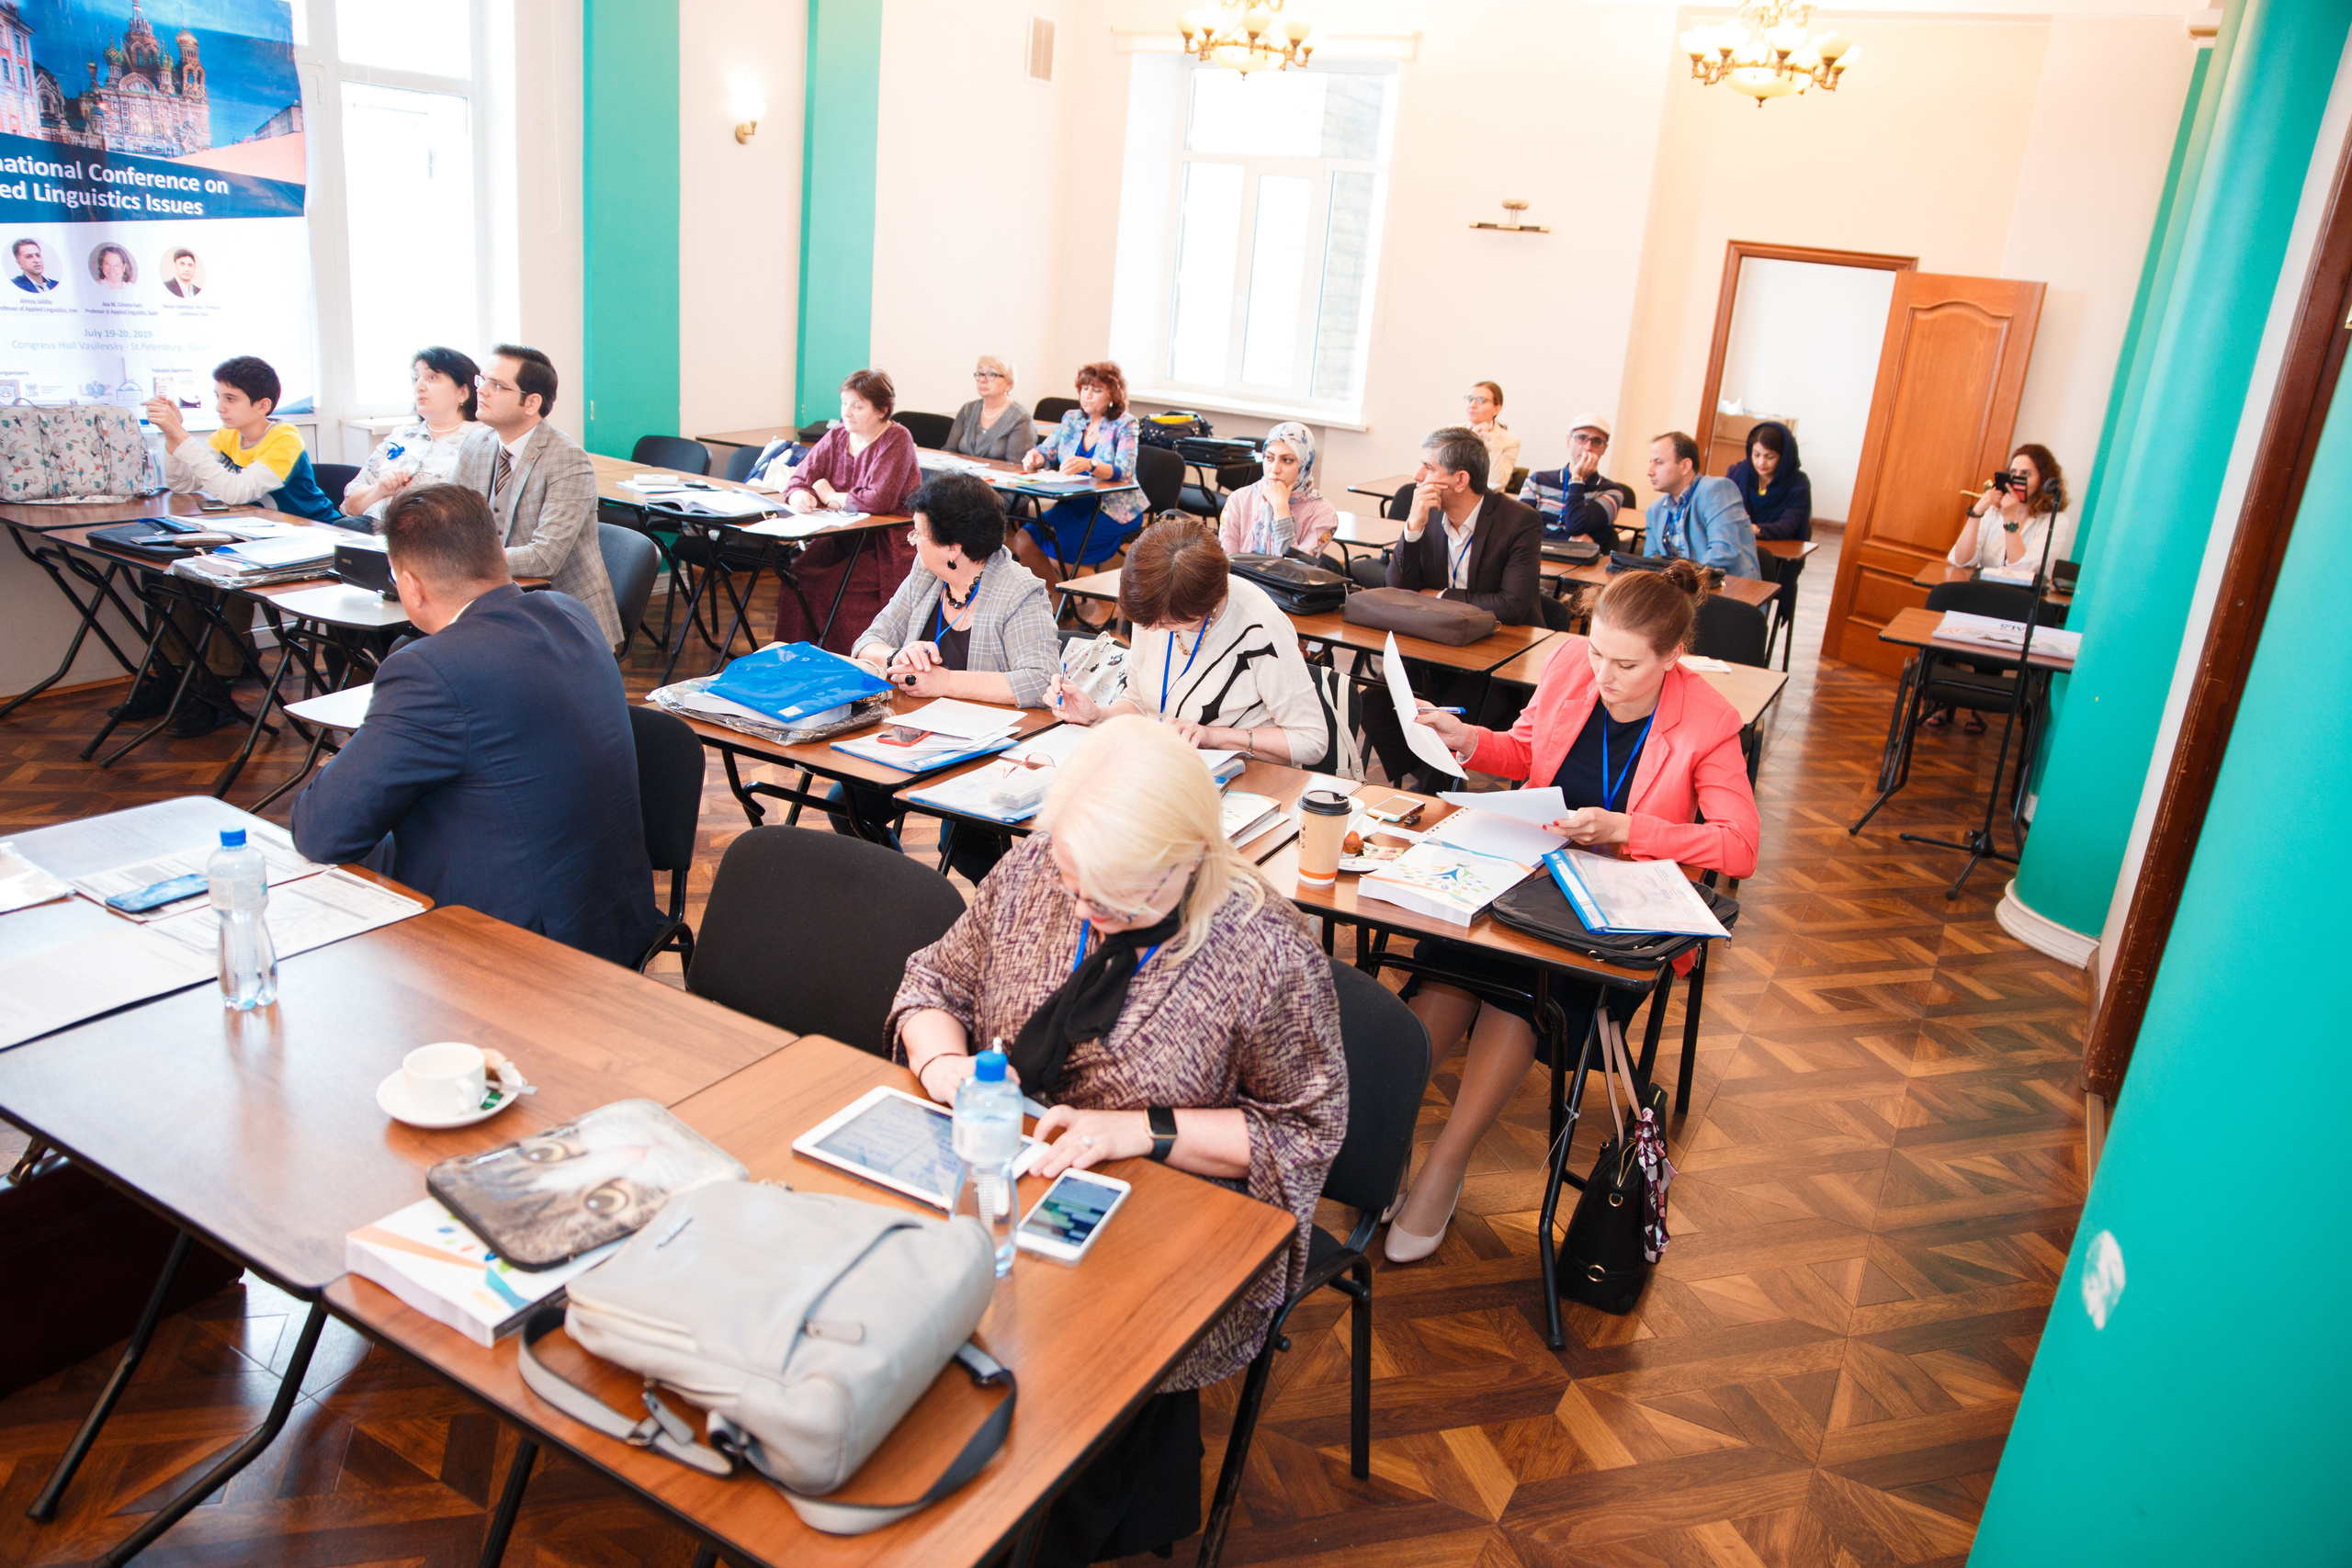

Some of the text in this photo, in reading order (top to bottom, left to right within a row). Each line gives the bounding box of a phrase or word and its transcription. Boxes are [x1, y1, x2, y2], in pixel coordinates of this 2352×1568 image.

[88, 164, 200, 193] Conference
[204, 177, 229, 194] on
[0, 180, 203, 215] ed Linguistics Issues
[84, 329, 153, 339] July 19-20, 2019
[11, 340, 56, 351] Congress
[58, 341, 76, 350] Hall
[78, 341, 124, 352] Vasilevsky
[130, 342, 183, 353] St.Petersburg
